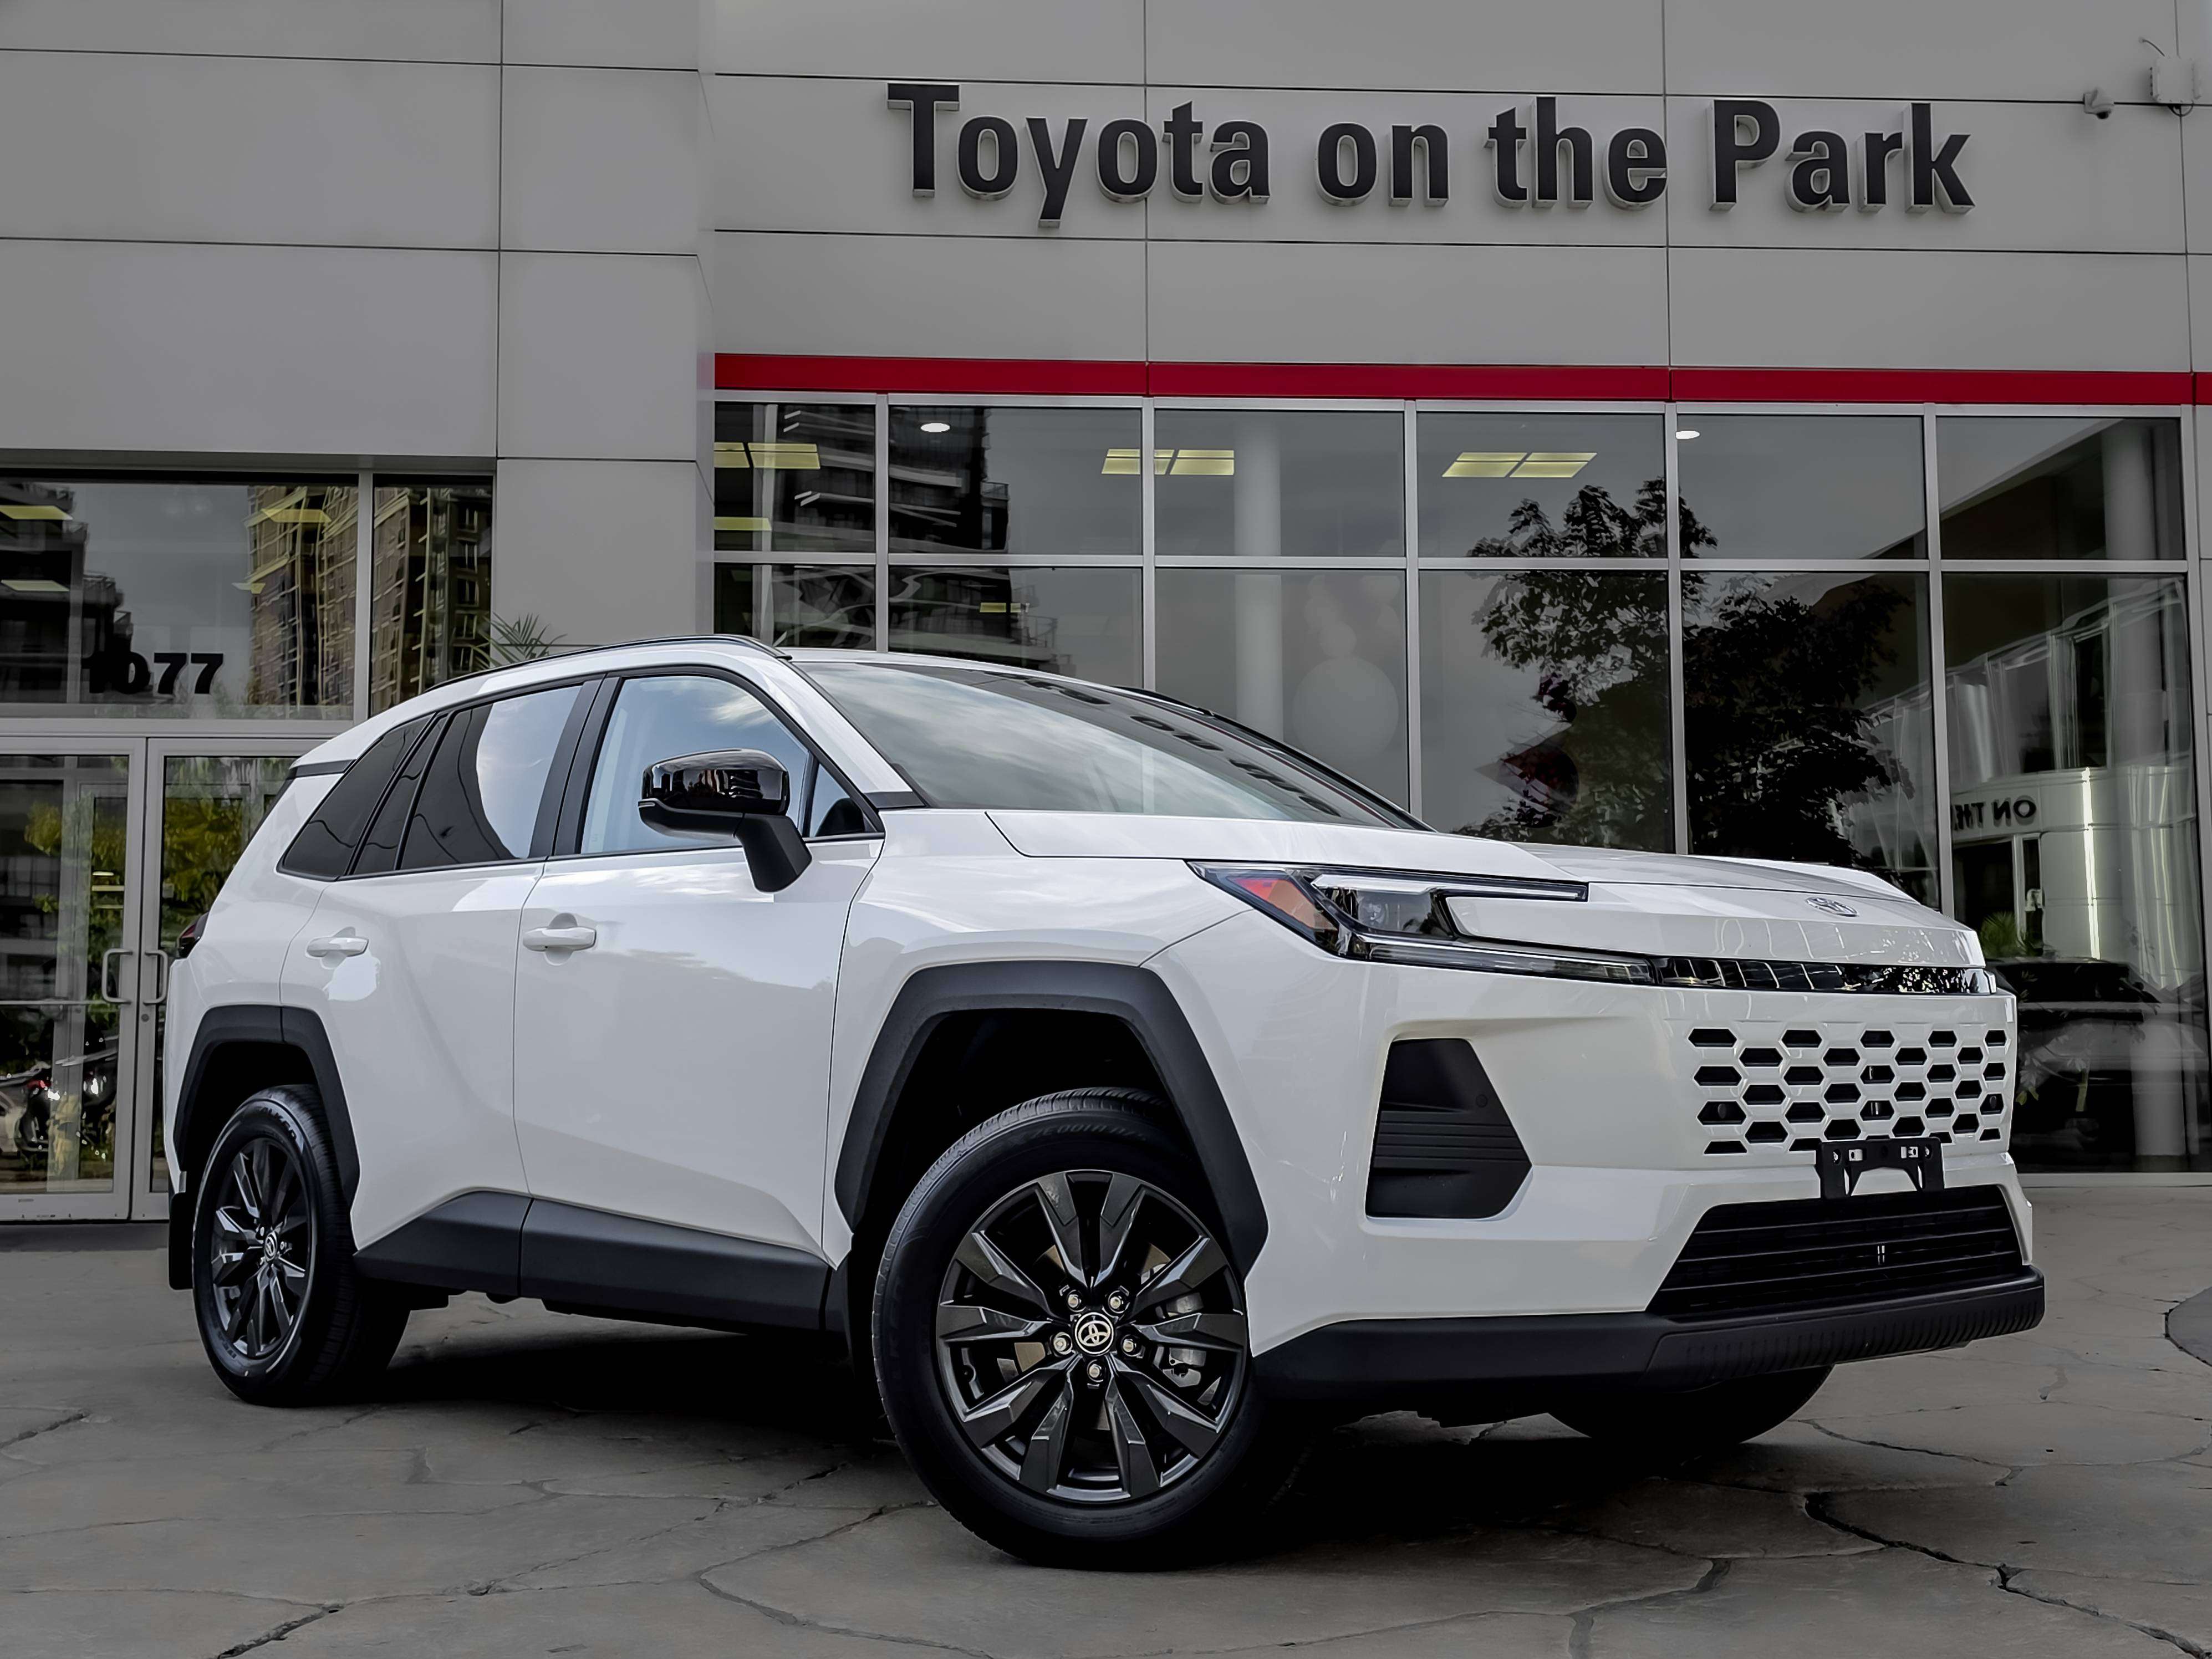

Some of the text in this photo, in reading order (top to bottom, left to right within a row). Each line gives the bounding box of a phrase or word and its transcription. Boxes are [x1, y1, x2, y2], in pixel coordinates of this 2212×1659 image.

[887, 83, 1975, 226] Toyota on the Park
